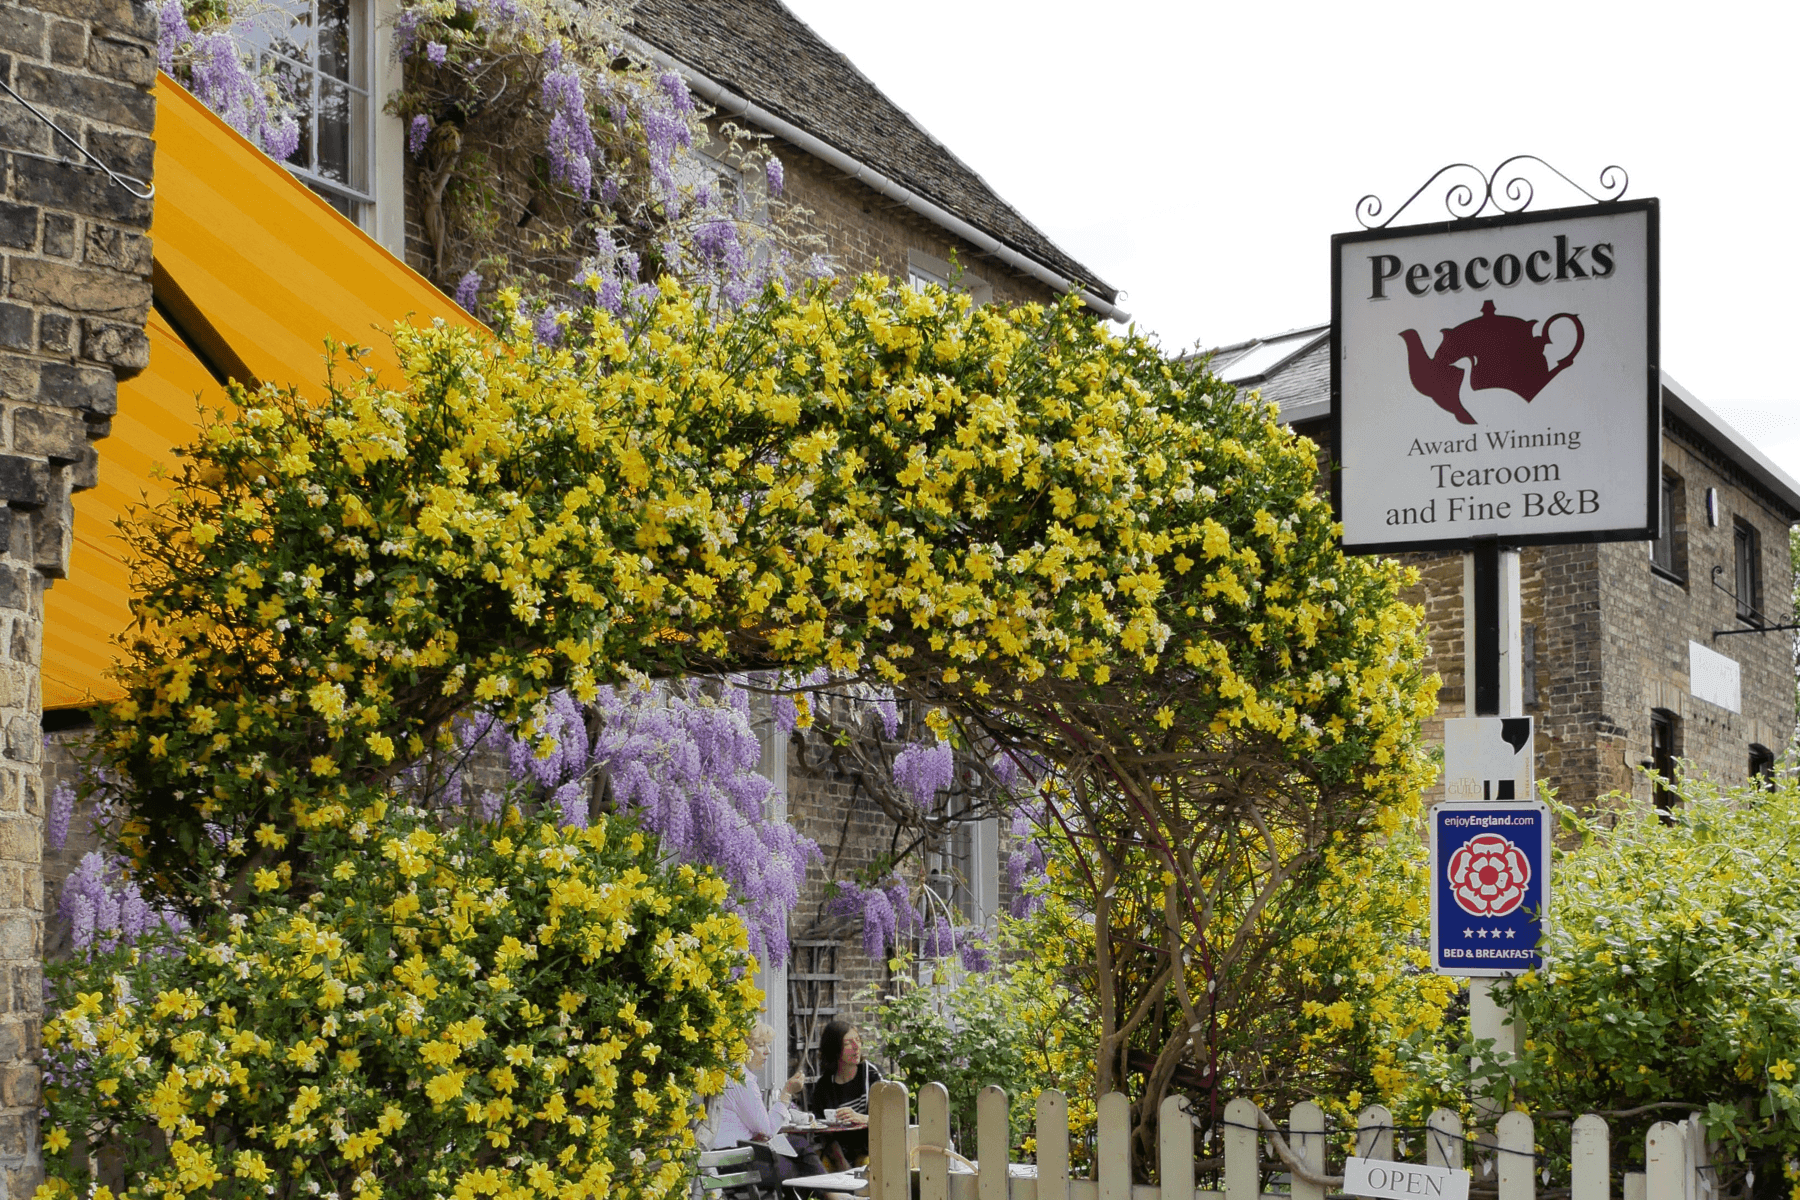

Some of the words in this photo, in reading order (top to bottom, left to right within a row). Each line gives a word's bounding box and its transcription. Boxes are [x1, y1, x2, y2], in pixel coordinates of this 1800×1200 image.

[1367, 234, 1615, 301] Peacocks
[1407, 433, 1478, 456] Award
[1485, 427, 1581, 450] Winning
[1430, 463, 1561, 489] Tearoom
[1386, 499, 1437, 526] and
[1447, 496, 1511, 522] Fine
[1522, 489, 1600, 518] B&B
[1447, 785, 1482, 795] GUILD
[1444, 815, 1534, 828] enjoyEngland.com
[1443, 948, 1464, 958] BED
[1465, 949, 1474, 958] &
[1475, 948, 1535, 959] BREAKFAST
[1367, 1167, 1445, 1197] OPEN
